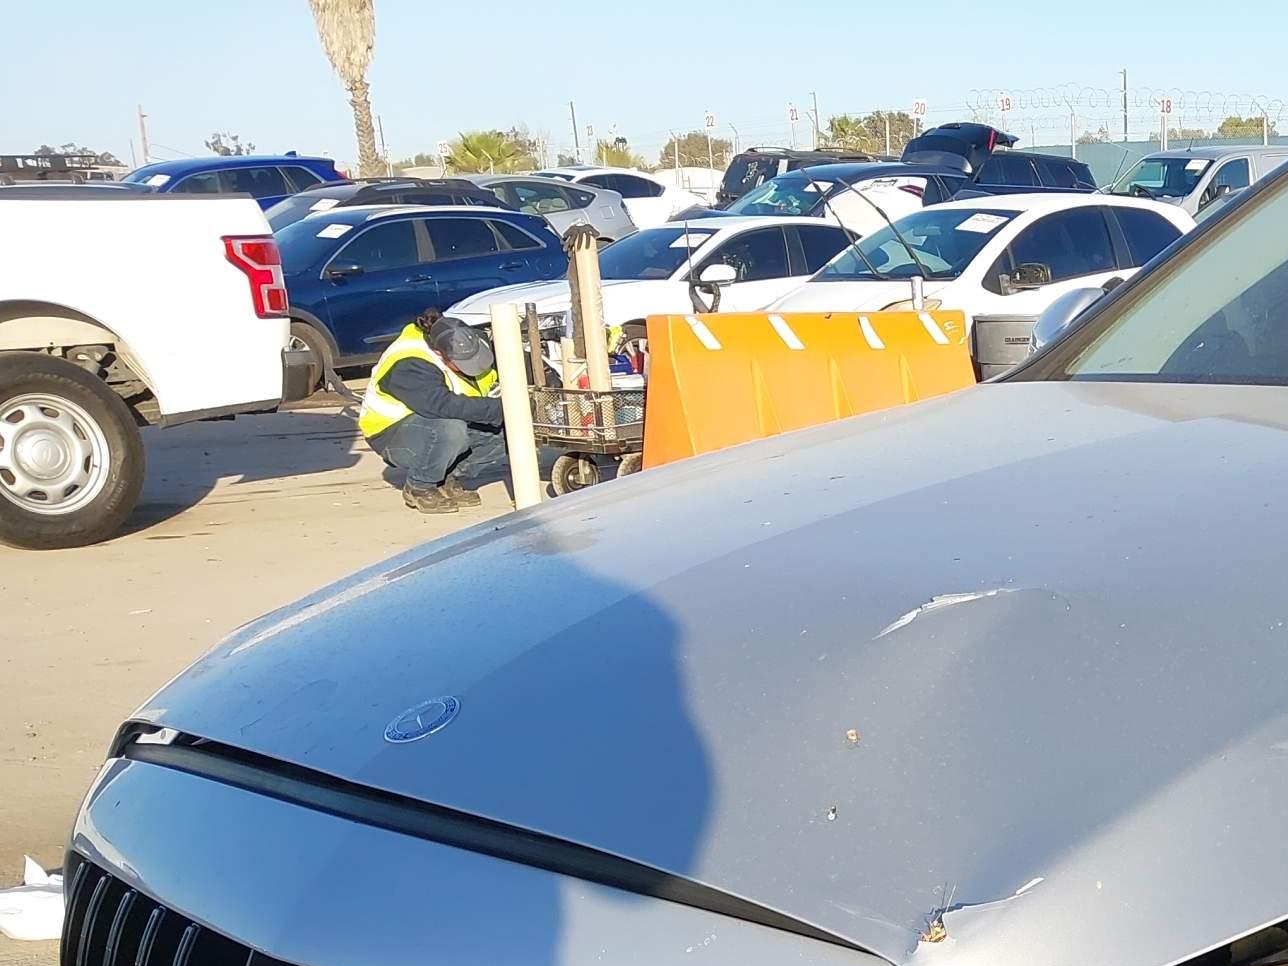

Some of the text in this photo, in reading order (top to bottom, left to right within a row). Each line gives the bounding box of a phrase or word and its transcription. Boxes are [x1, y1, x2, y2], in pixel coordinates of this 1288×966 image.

[914, 102, 926, 115] 20
[1000, 97, 1011, 111] 19
[1161, 99, 1172, 113] 18
[789, 108, 799, 120] 21
[705, 115, 715, 127] 22
